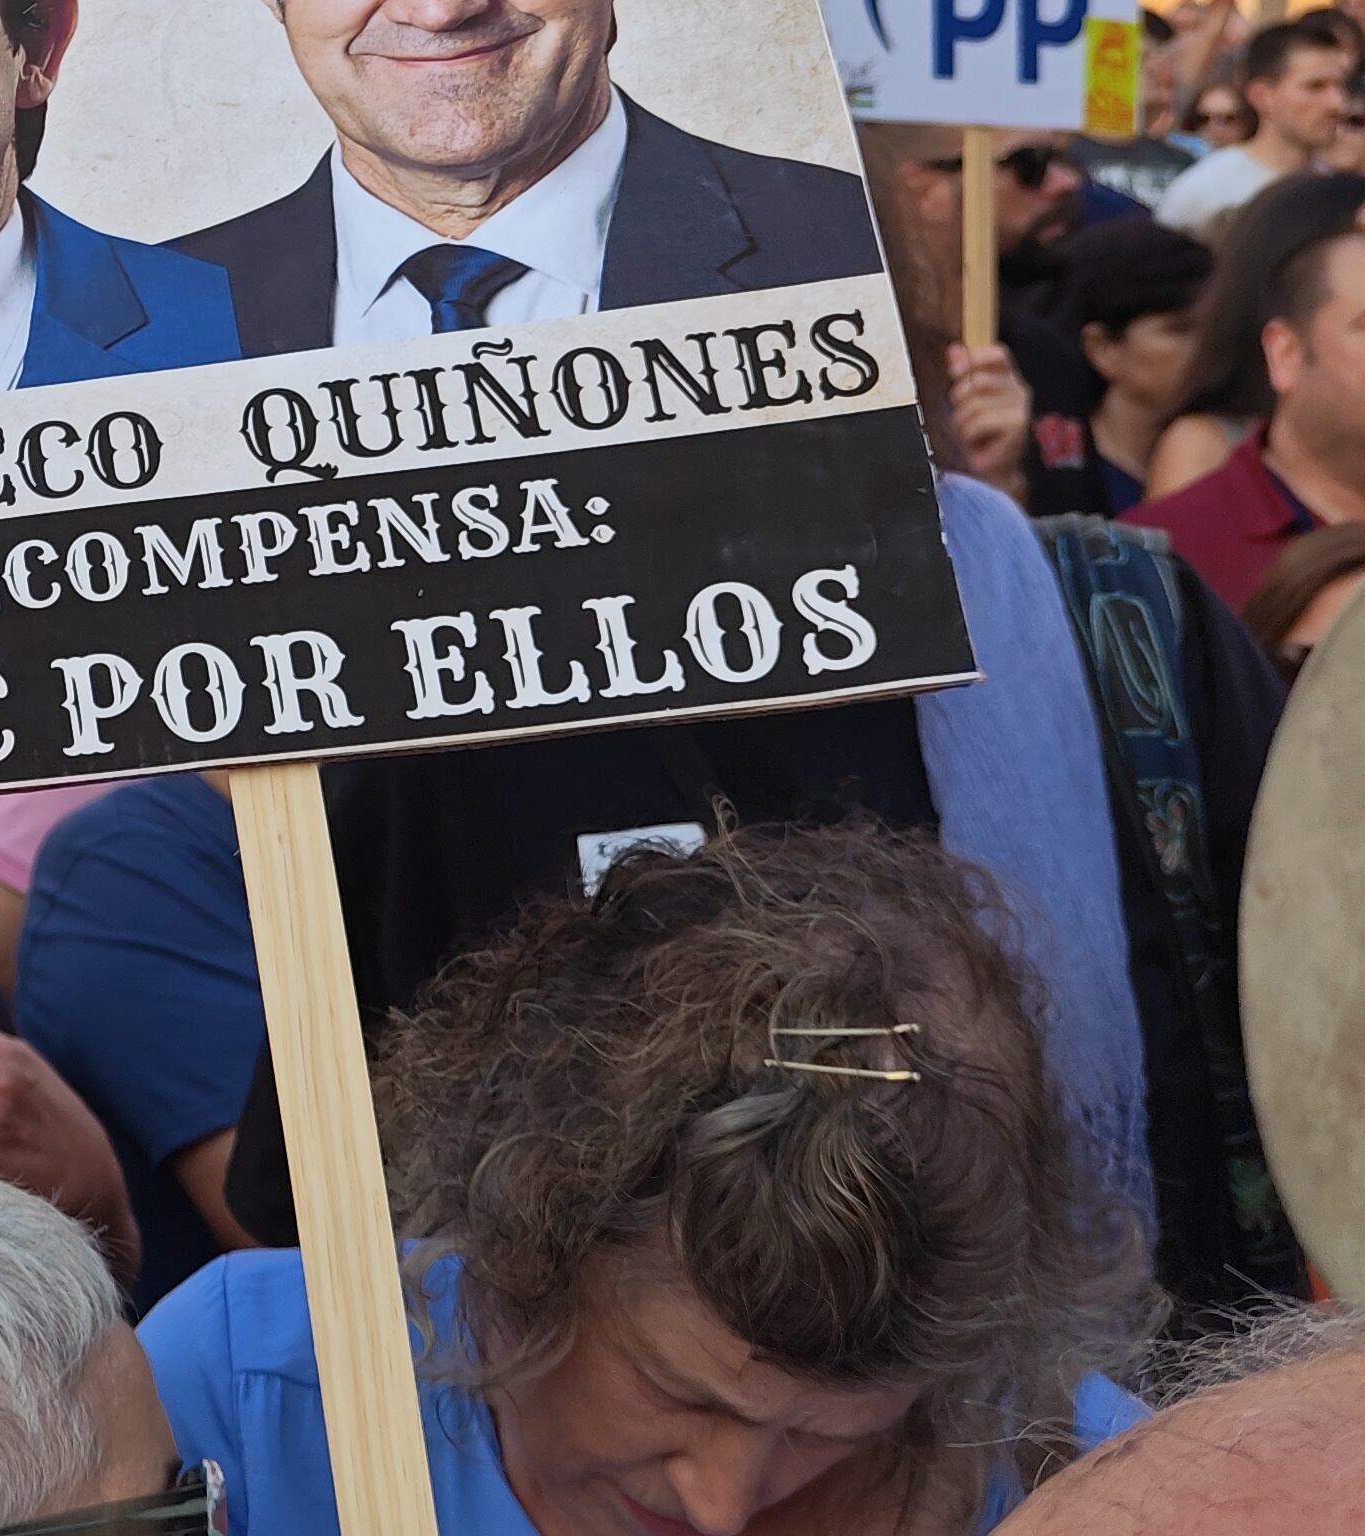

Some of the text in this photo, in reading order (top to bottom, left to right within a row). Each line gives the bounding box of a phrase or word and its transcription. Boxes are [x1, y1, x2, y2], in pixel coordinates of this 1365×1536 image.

[240, 309, 882, 482] QUIÑONES
[53, 624, 366, 760] POR
[389, 563, 879, 720] ELLOS
